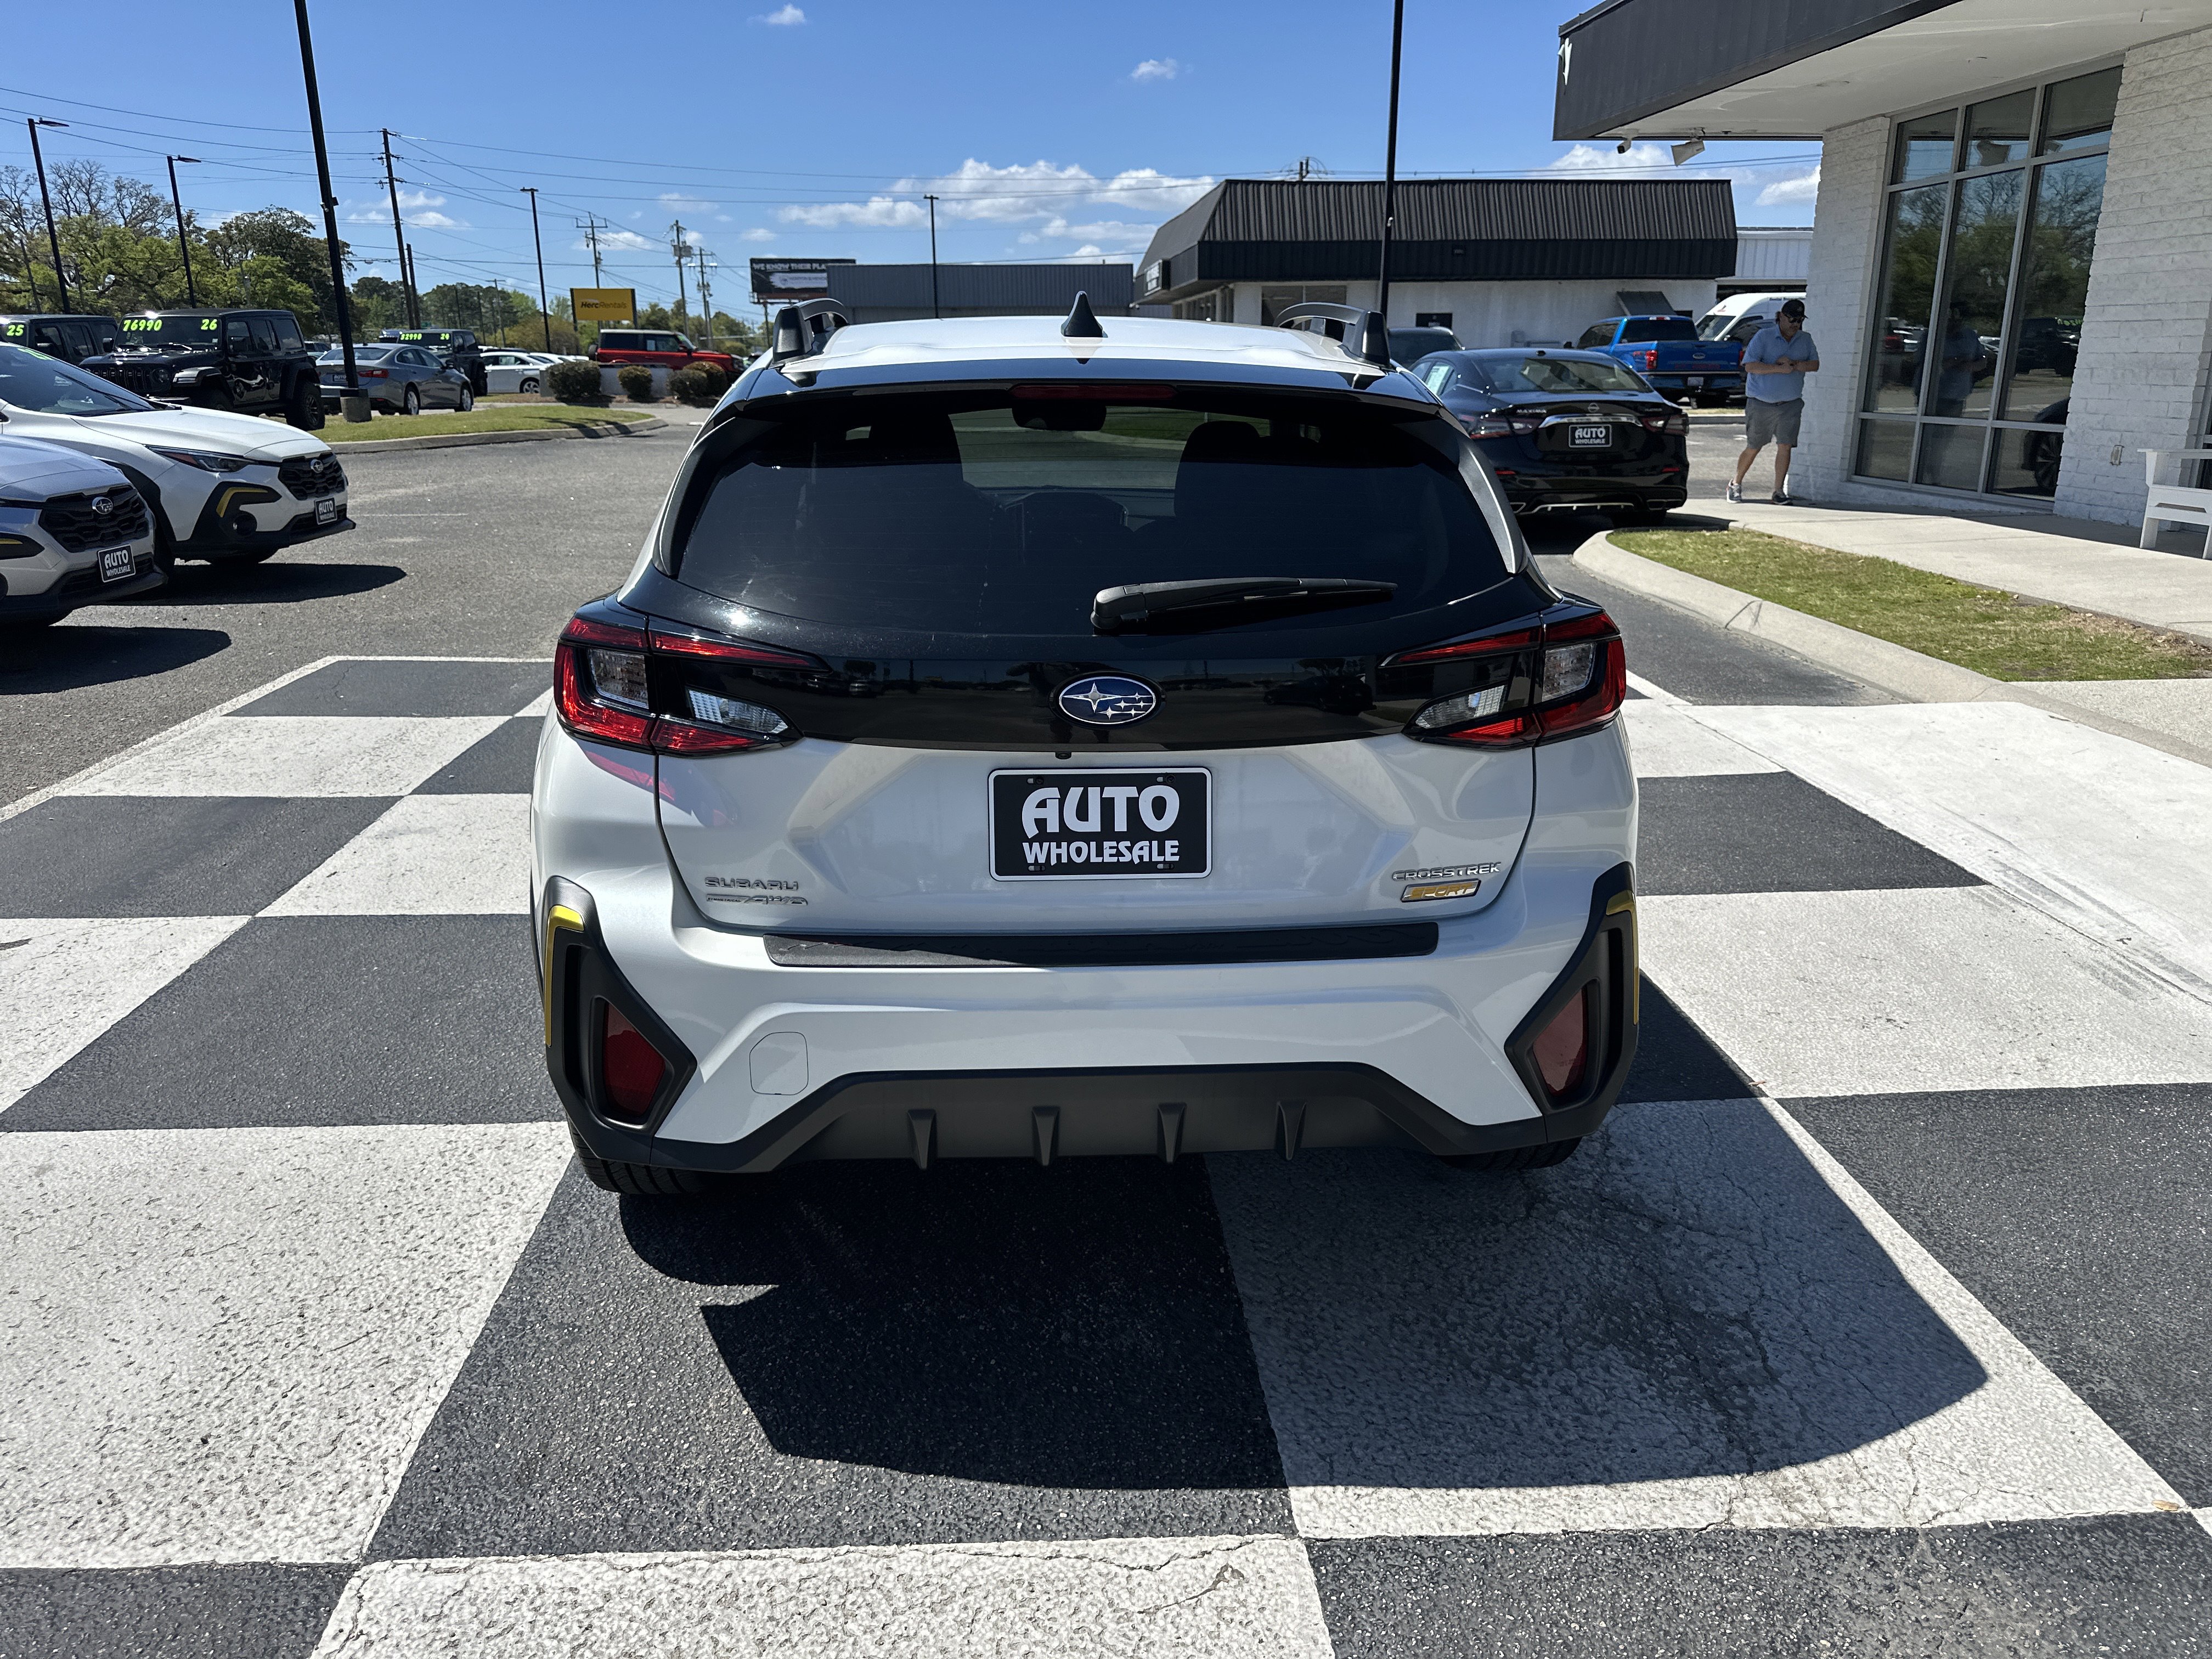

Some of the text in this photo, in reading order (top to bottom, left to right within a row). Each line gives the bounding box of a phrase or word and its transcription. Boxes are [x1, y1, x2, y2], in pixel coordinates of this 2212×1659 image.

[7, 324, 24, 336] 25
[123, 319, 218, 332] 76990 26
[1575, 427, 1606, 439] AUTO
[319, 500, 334, 515] AUTO
[104, 549, 128, 569] AUTO
[106, 565, 131, 577] WHOLESALE
[1022, 785, 1180, 838] AUTO
[1022, 840, 1180, 866] WHOLESALE
[1392, 861, 1502, 882] CROSSTREK
[704, 877, 799, 891] SUBARU
[1409, 882, 1473, 899] SPORT
[744, 895, 808, 906] AWD
